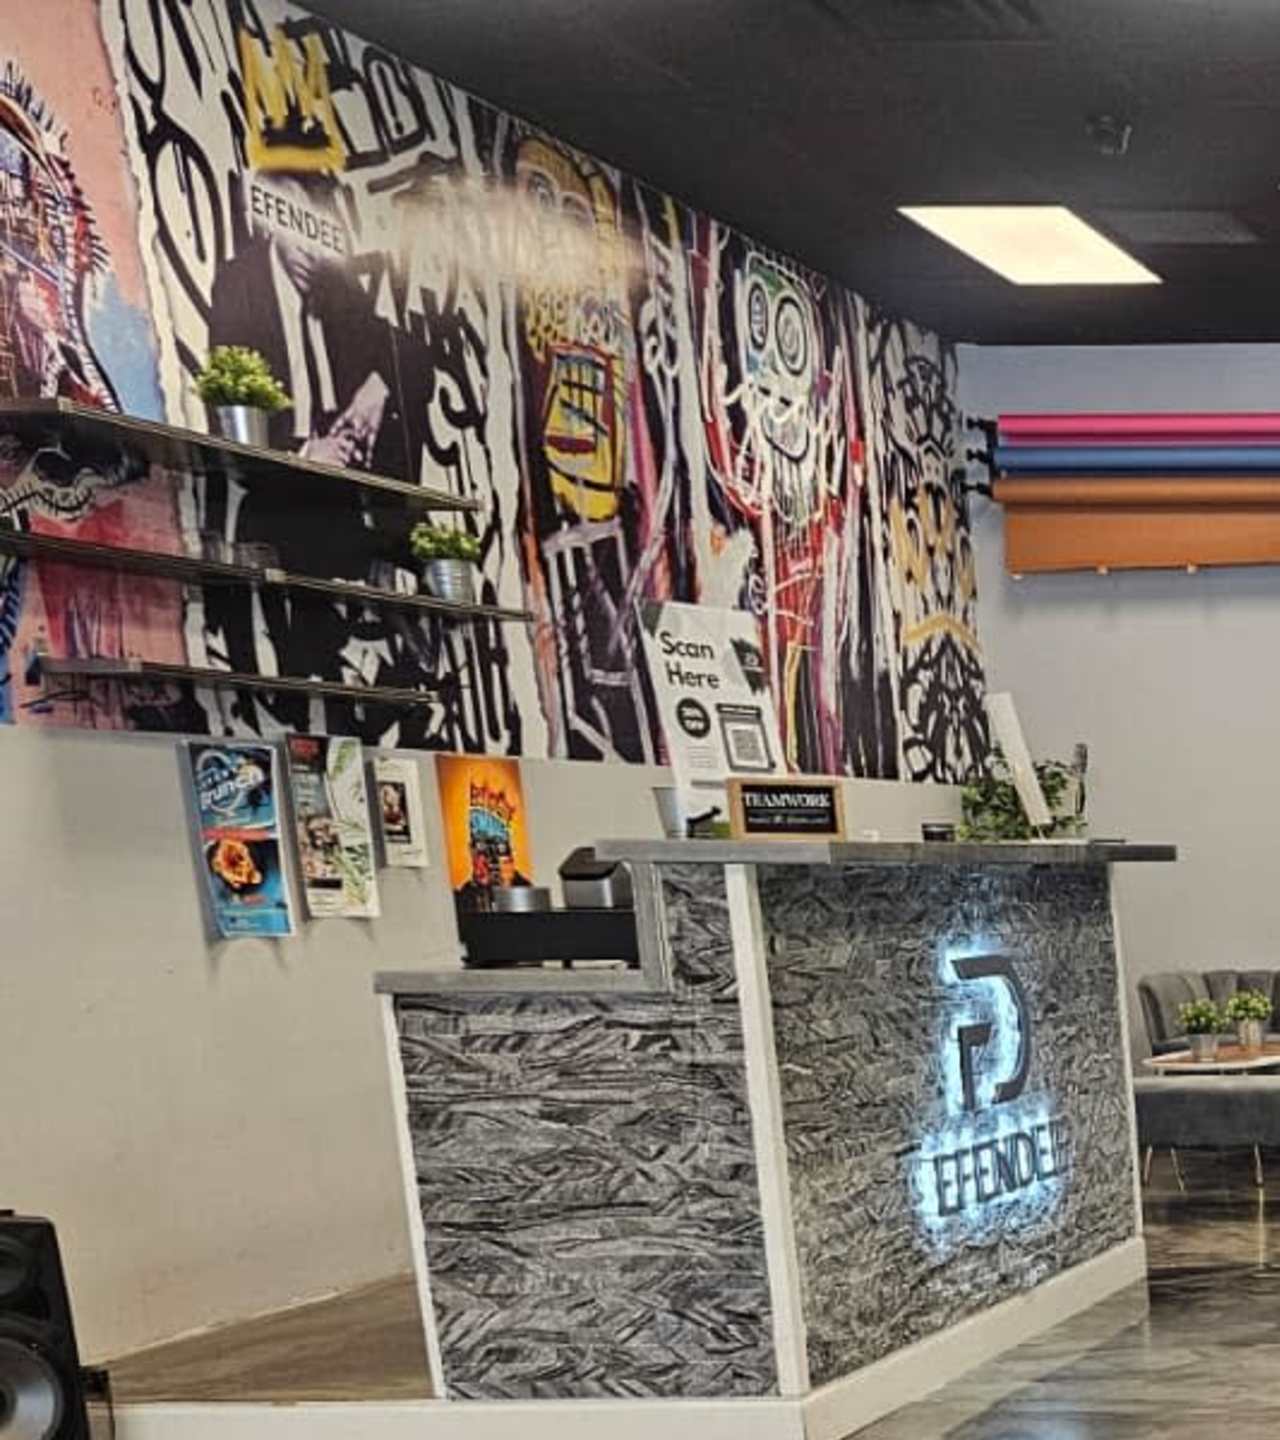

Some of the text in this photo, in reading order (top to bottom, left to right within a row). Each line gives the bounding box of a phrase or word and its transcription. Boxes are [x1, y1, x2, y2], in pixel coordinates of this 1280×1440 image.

[250, 184, 345, 254] EFENDEE
[659, 630, 715, 661] Scan
[664, 662, 721, 690] Here
[744, 789, 831, 808] TEAMWORK
[934, 1118, 1073, 1218] EFENDEE
